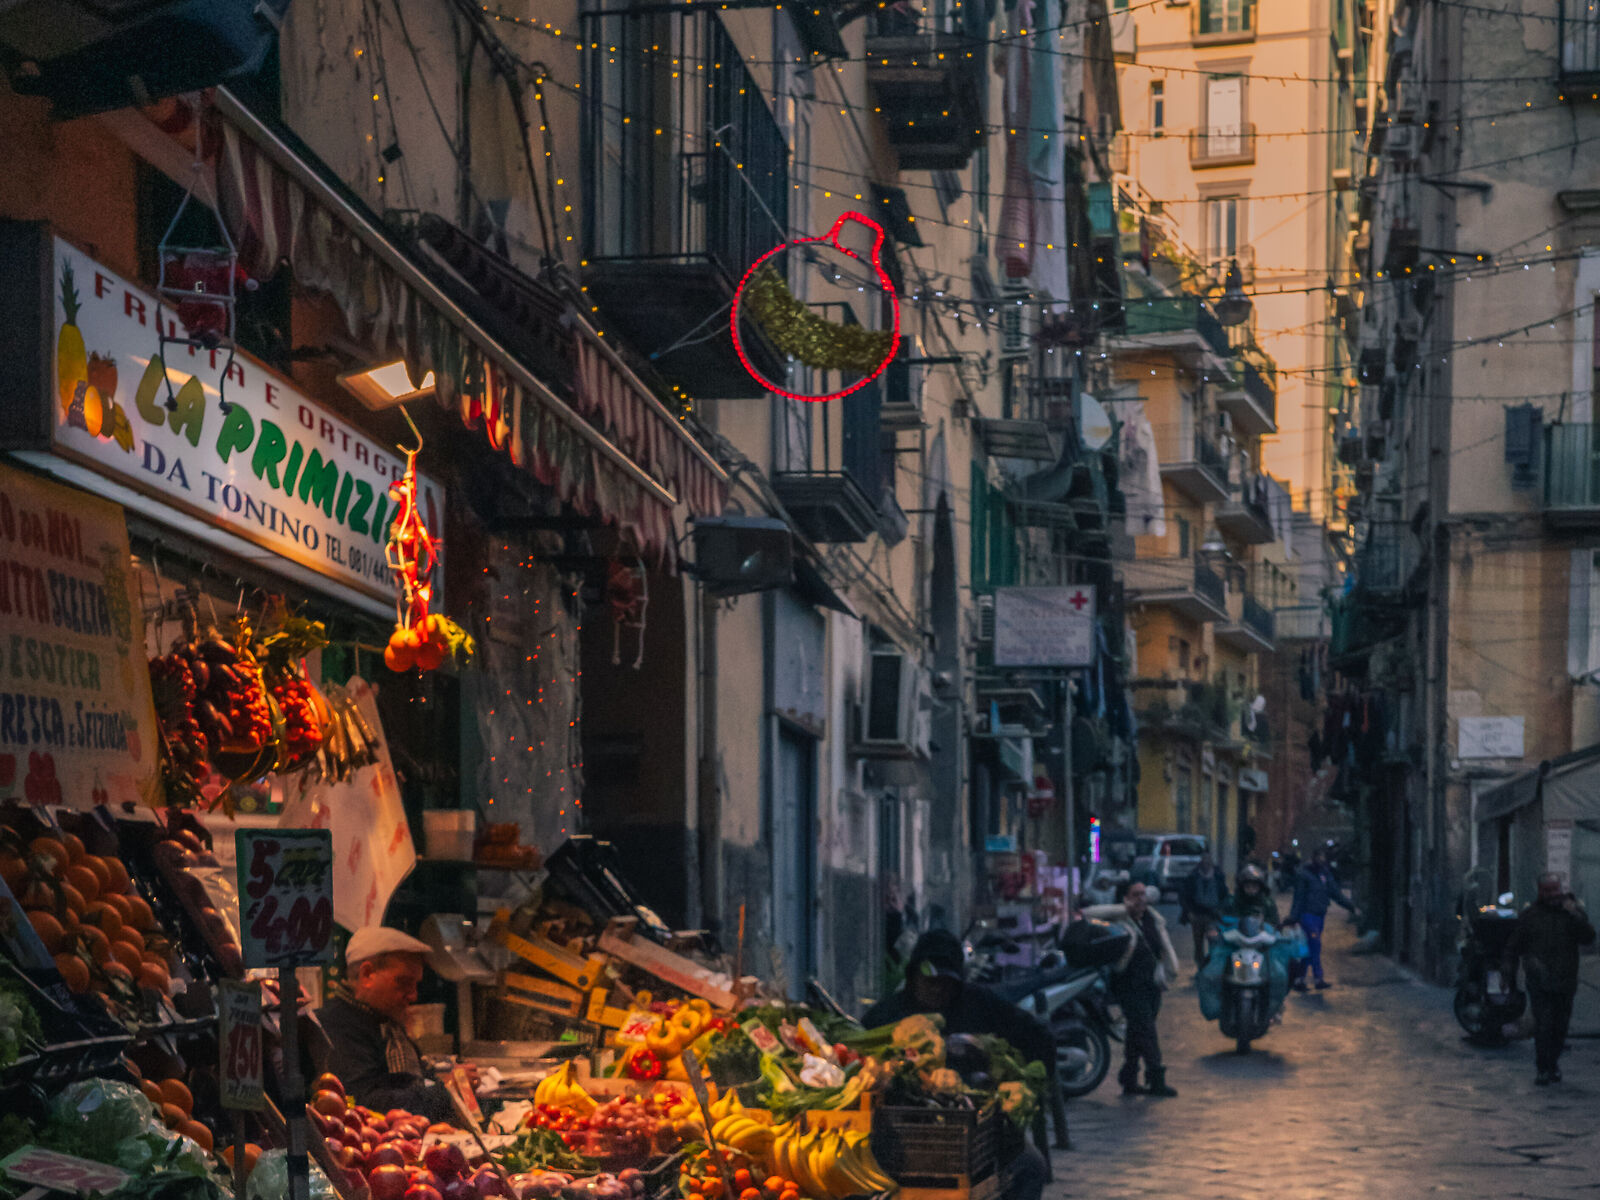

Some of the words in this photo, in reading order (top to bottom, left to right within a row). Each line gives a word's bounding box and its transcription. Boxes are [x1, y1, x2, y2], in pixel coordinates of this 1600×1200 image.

[135, 353, 206, 448] LA
[265, 382, 281, 409] E
[298, 405, 404, 484] ORTAGG
[141, 440, 191, 491] DA
[202, 471, 319, 551] TONINO
[47, 568, 112, 637] SCELTA
[9, 633, 101, 692] ESOTICA
[0, 692, 65, 746] RESCA
[246, 839, 280, 899] 5
